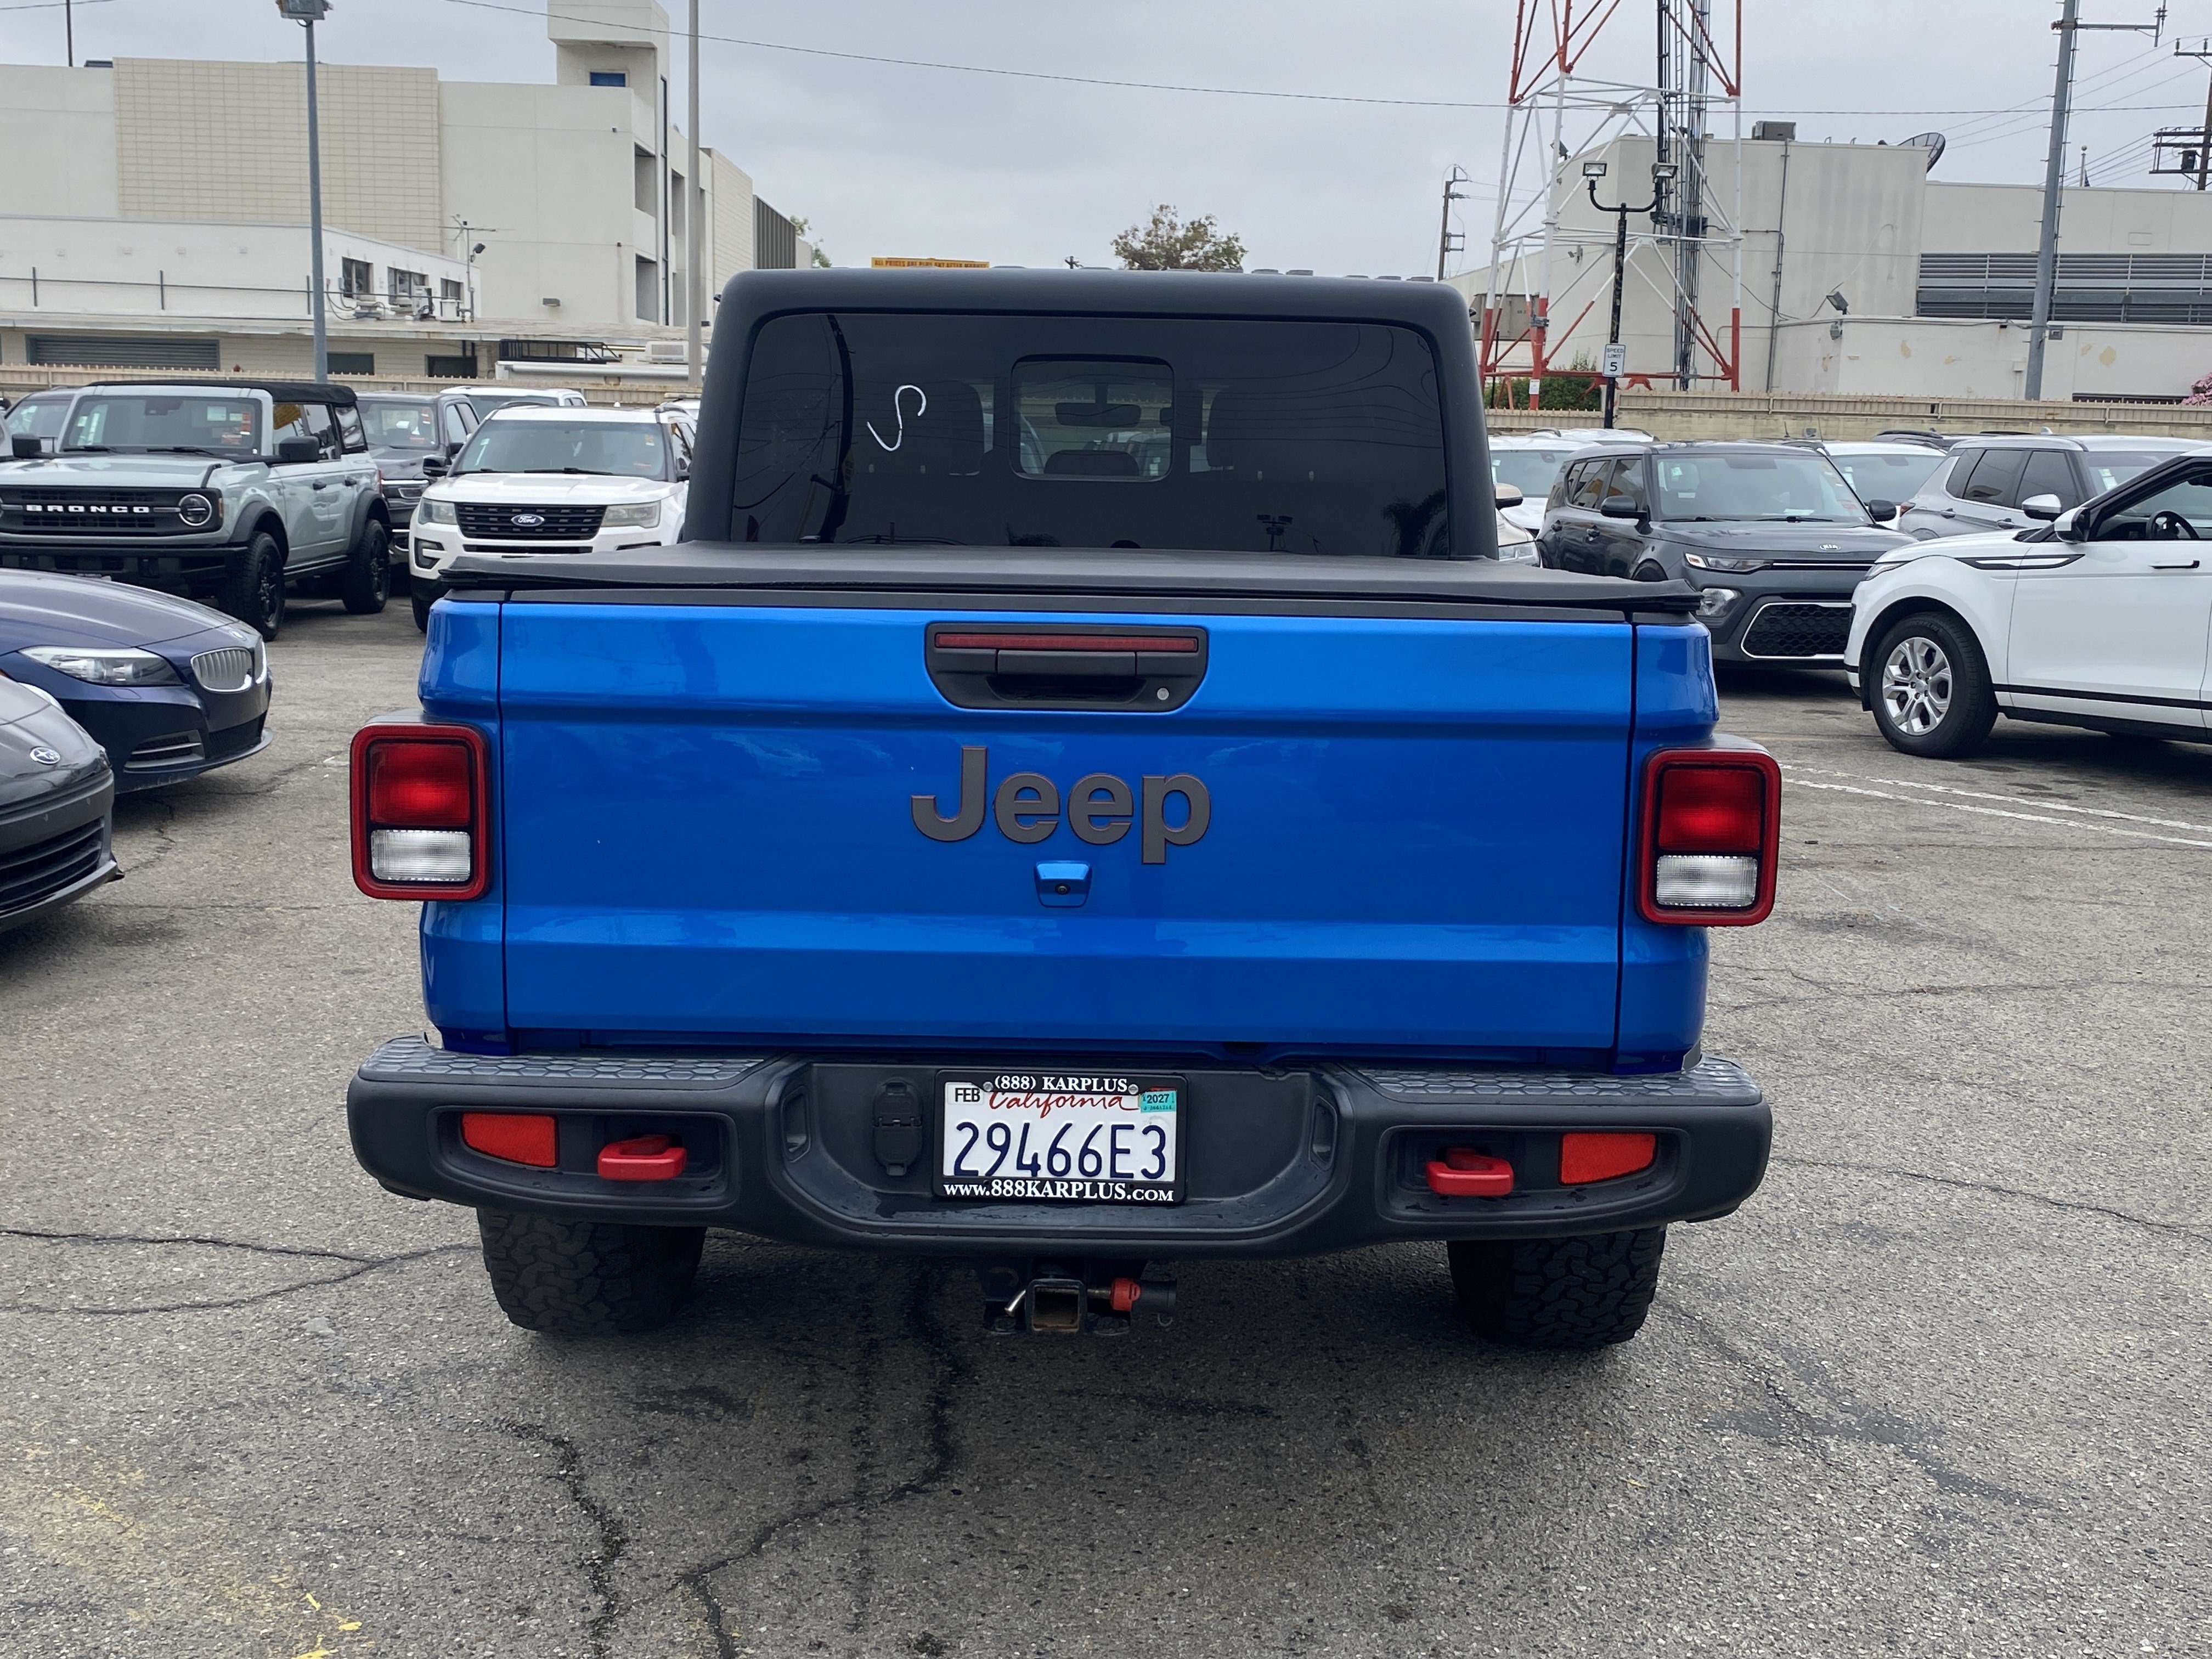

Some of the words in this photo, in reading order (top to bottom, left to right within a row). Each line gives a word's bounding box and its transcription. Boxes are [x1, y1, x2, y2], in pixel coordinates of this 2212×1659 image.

[1610, 362, 1617, 371] 5
[26, 504, 150, 513] BRONCO
[910, 746, 1212, 865] Jeep
[995, 1075, 1036, 1090] (888)
[1042, 1076, 1127, 1092] KARPLUS
[955, 1087, 980, 1102] FEB
[1147, 1093, 1170, 1104] 2027
[989, 1092, 1139, 1119] California
[953, 1121, 1166, 1180] 29466E3
